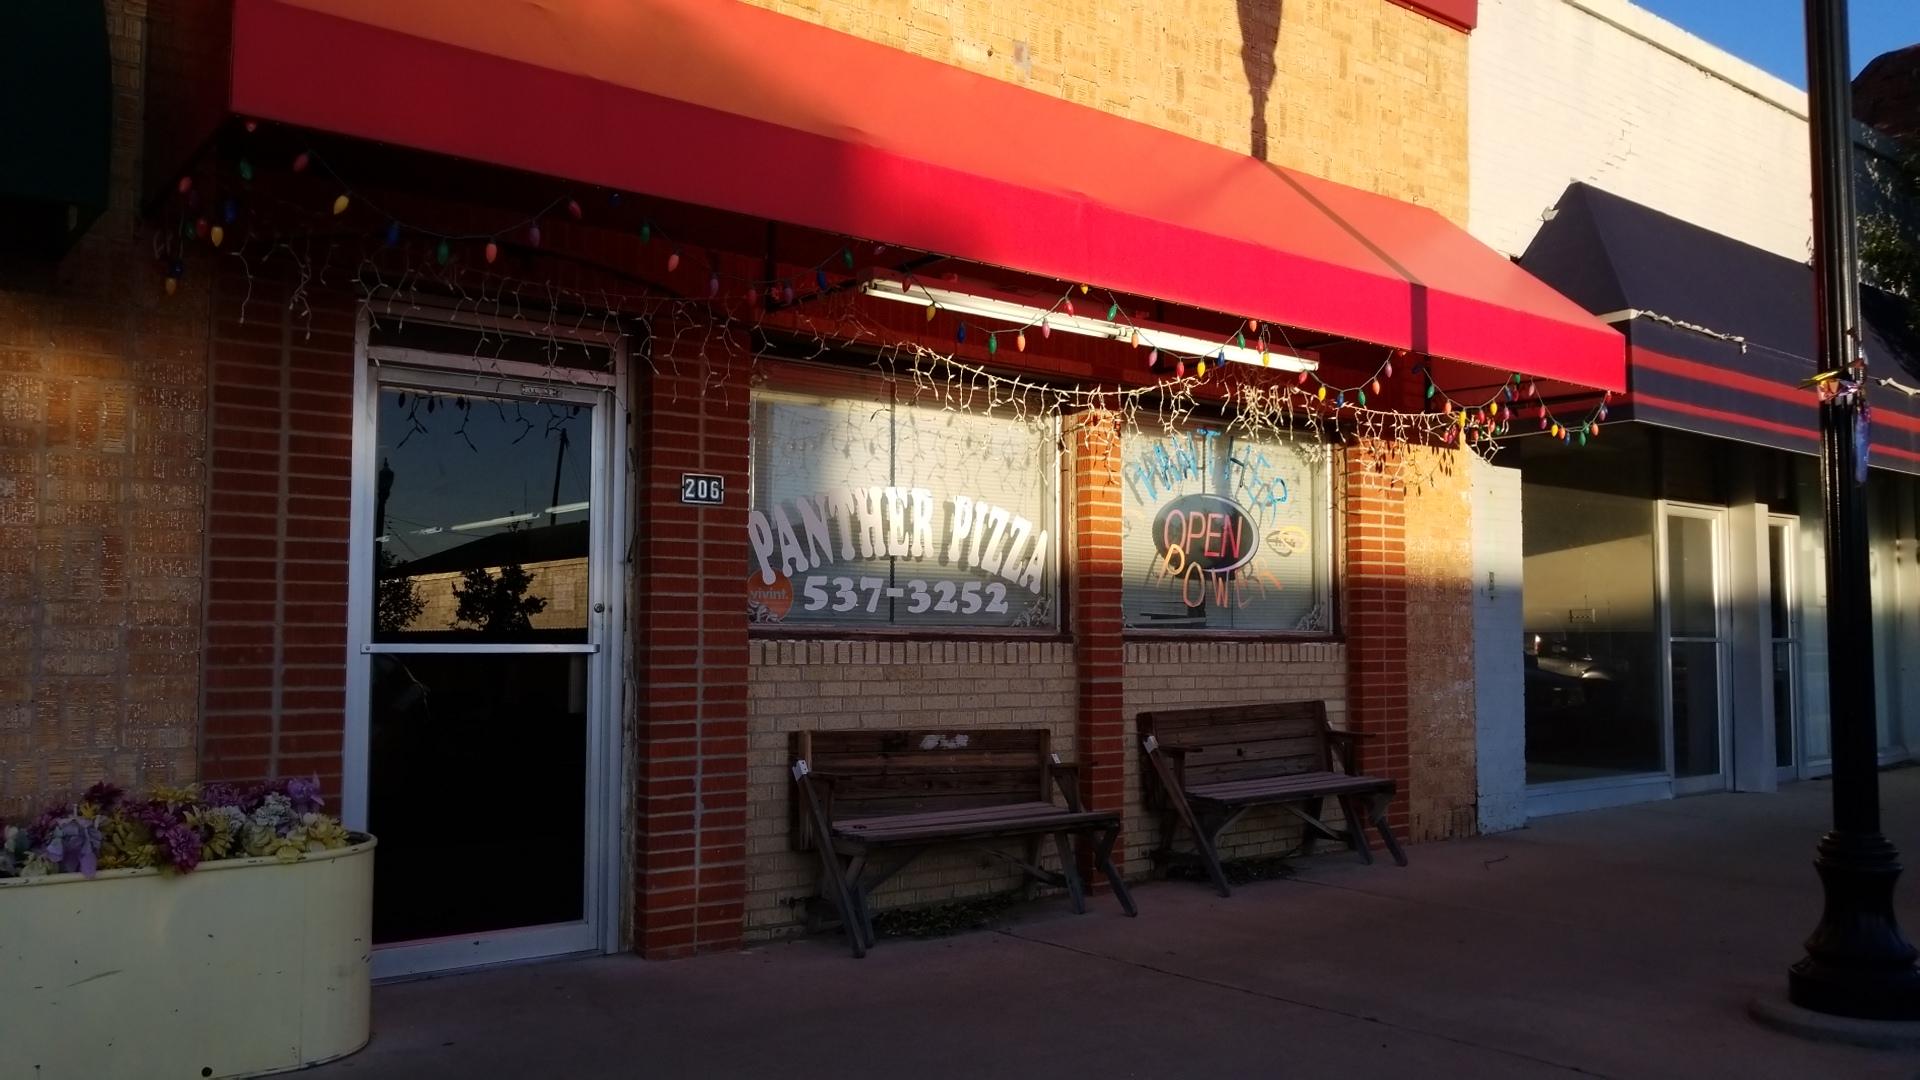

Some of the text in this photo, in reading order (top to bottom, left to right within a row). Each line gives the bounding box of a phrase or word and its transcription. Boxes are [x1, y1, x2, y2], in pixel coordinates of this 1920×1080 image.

[685, 479, 719, 499] 206
[750, 487, 1048, 595] PANTHER PIZZA
[1164, 509, 1242, 558] OPEN
[804, 576, 1009, 614] 537-3252
